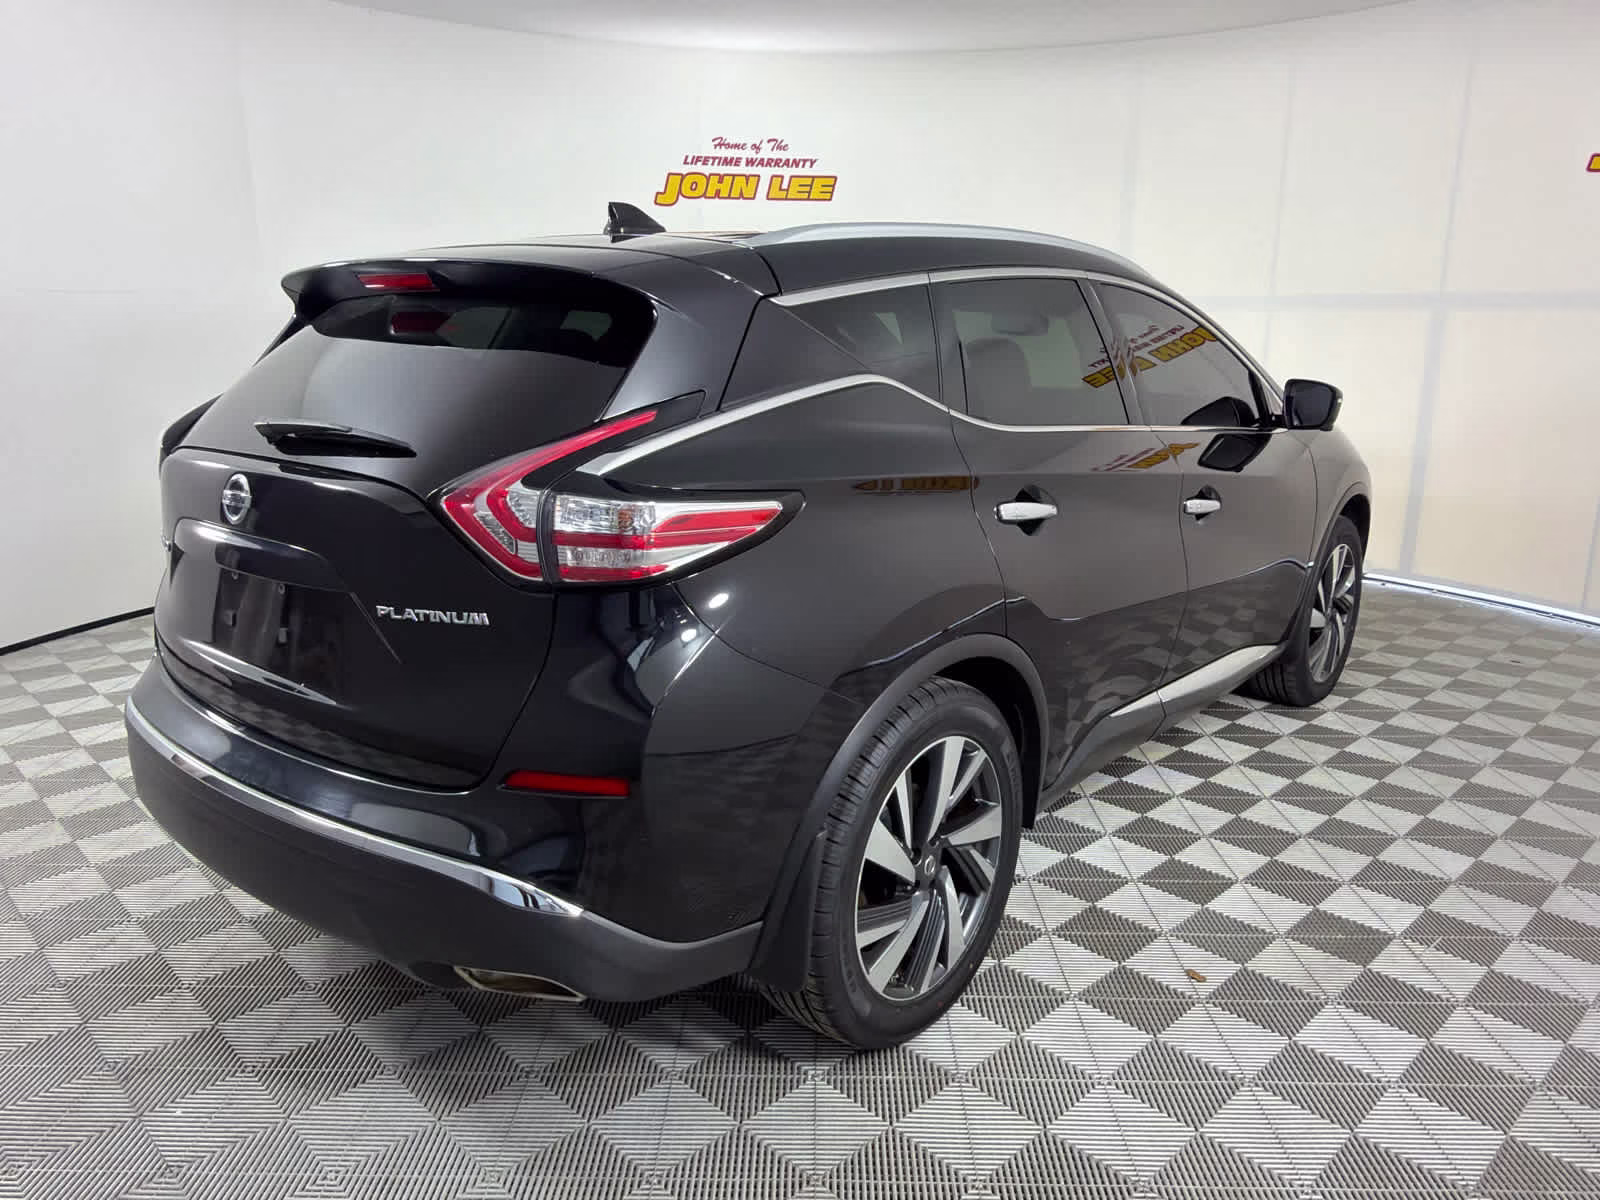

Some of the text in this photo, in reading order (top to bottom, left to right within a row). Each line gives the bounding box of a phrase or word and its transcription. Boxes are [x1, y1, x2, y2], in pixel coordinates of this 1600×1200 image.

[711, 136, 789, 154] Home of The
[683, 155, 818, 169] LIFETIME WARRANTY
[654, 172, 838, 206] JOHN LEE
[376, 605, 490, 626] PLATINUM
